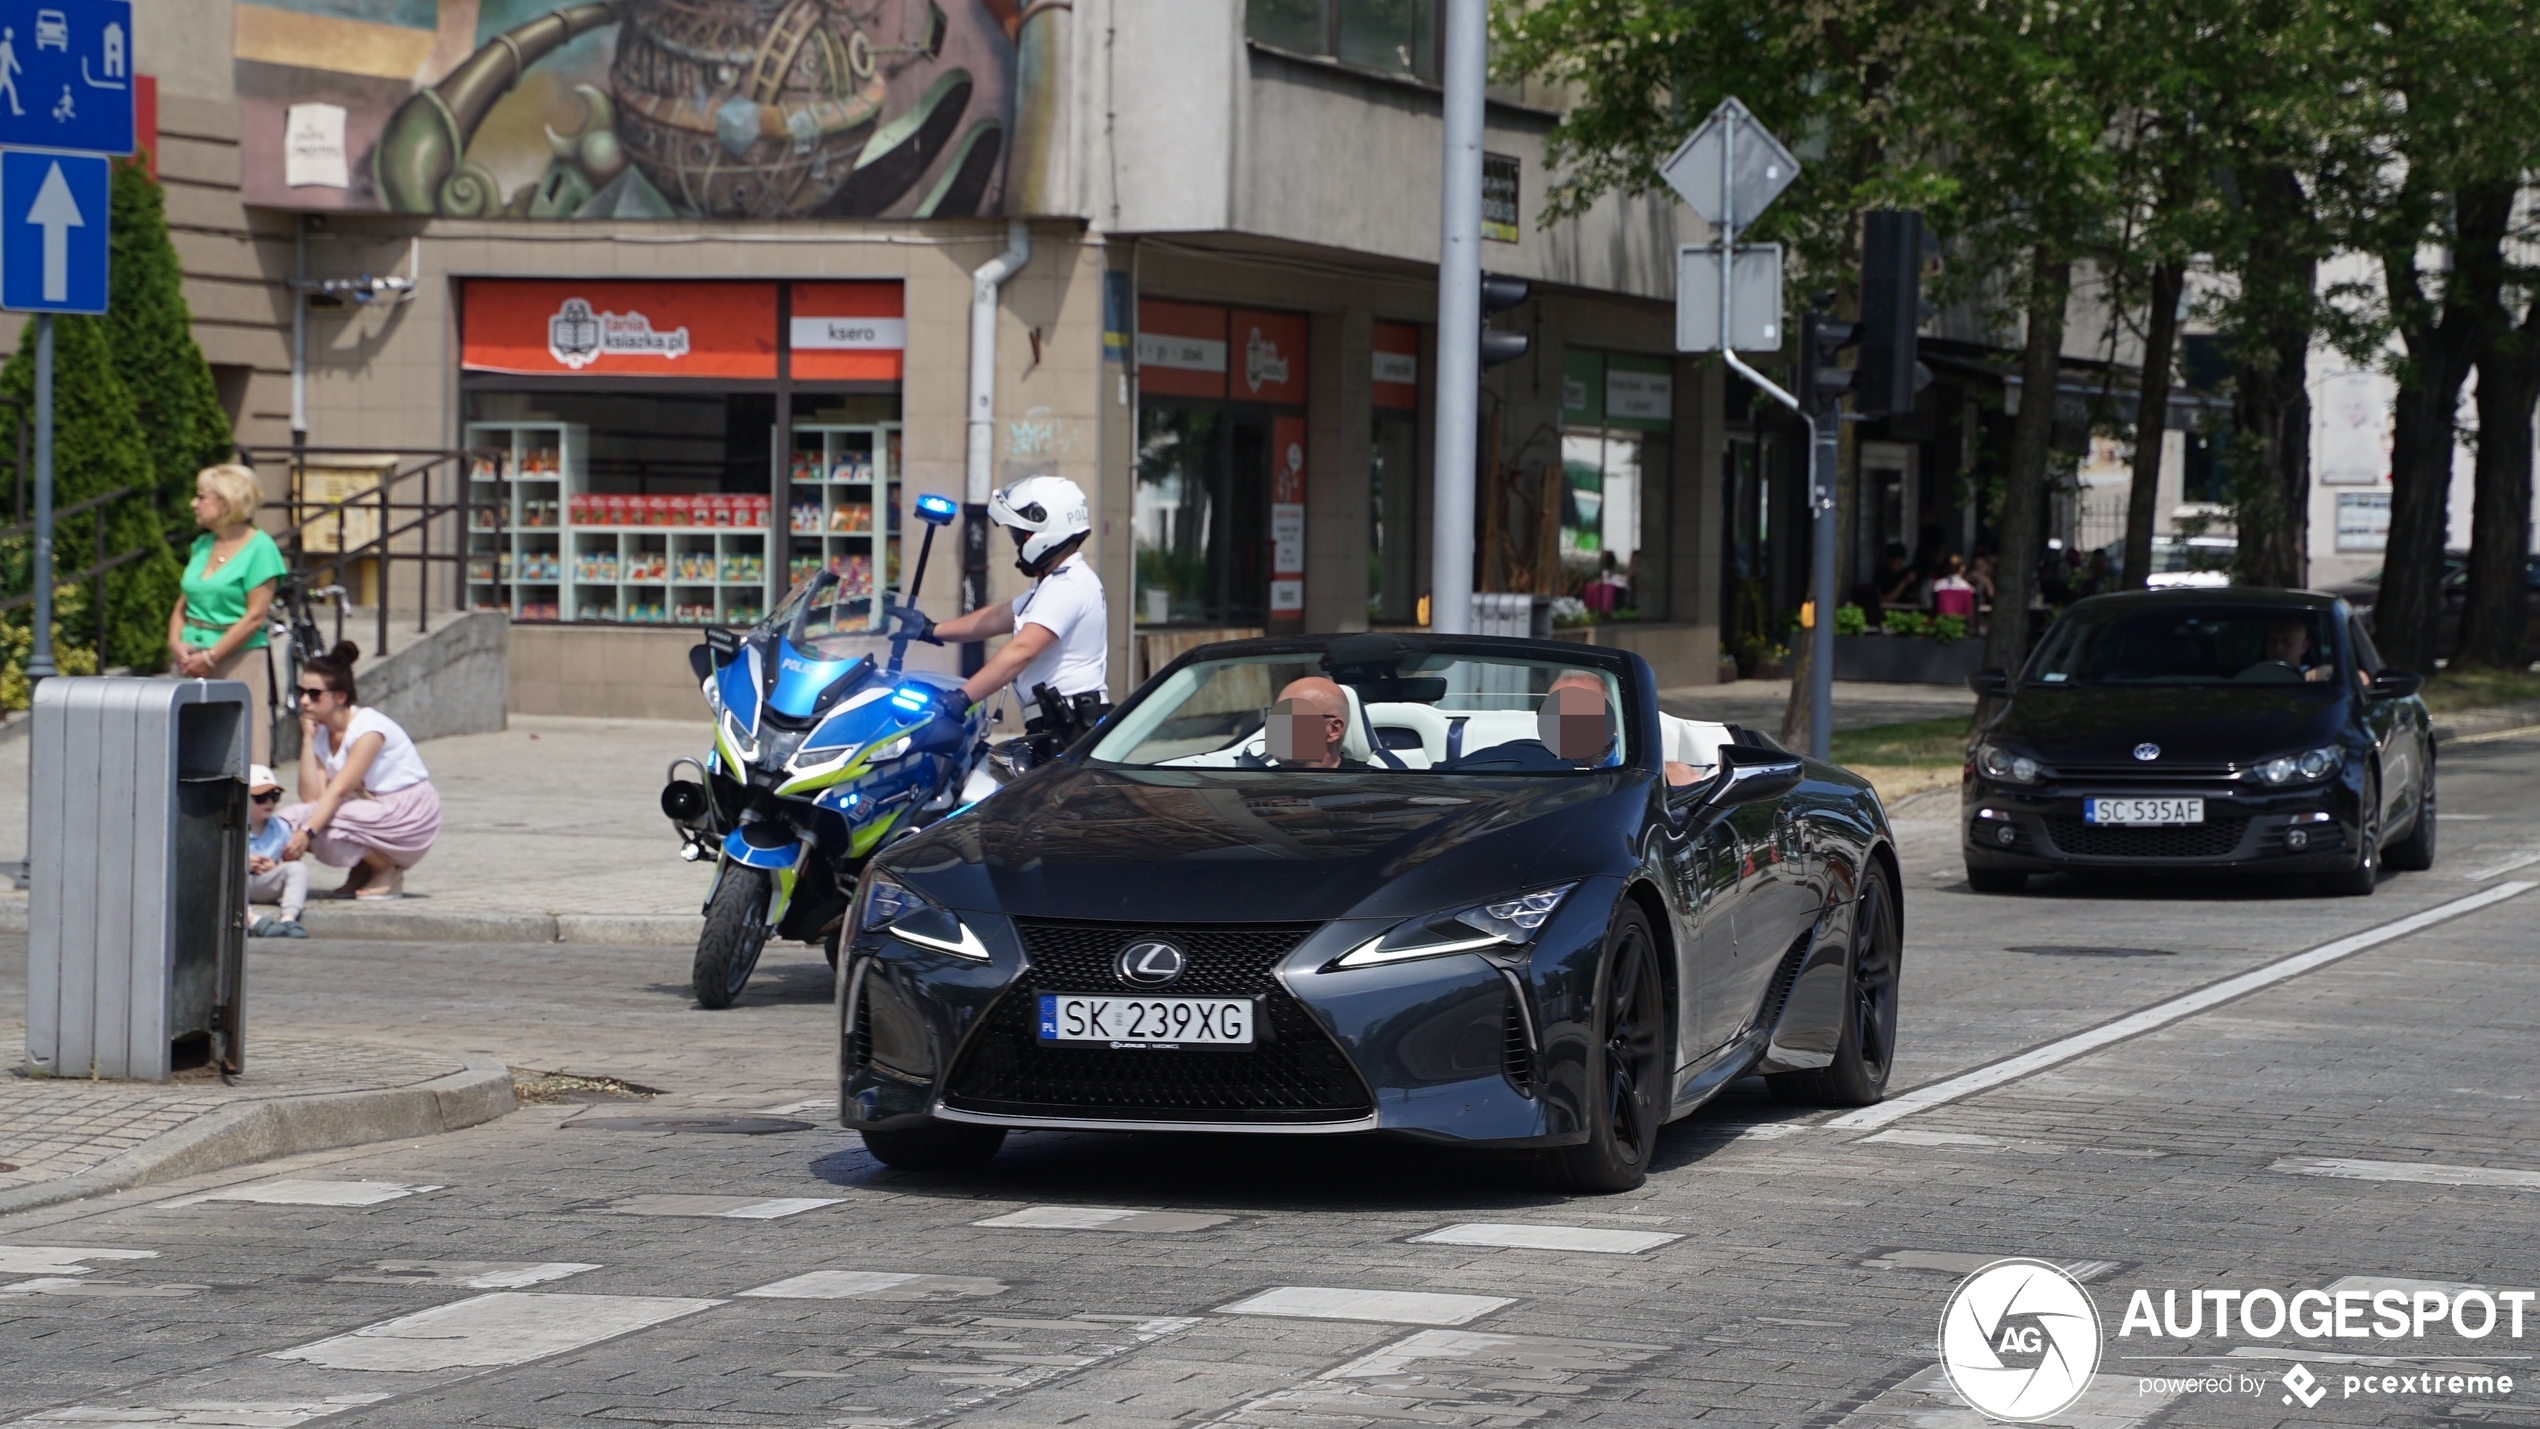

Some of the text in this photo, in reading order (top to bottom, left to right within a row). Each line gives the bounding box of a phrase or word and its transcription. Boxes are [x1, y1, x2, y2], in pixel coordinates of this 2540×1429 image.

[604, 314, 644, 331] tania
[828, 322, 876, 341] ksero
[1066, 508, 1089, 524] POL
[2099, 802, 2200, 821] SC 535AF
[1042, 1022, 1056, 1033] PL
[1066, 1000, 1242, 1039] SK 239XG
